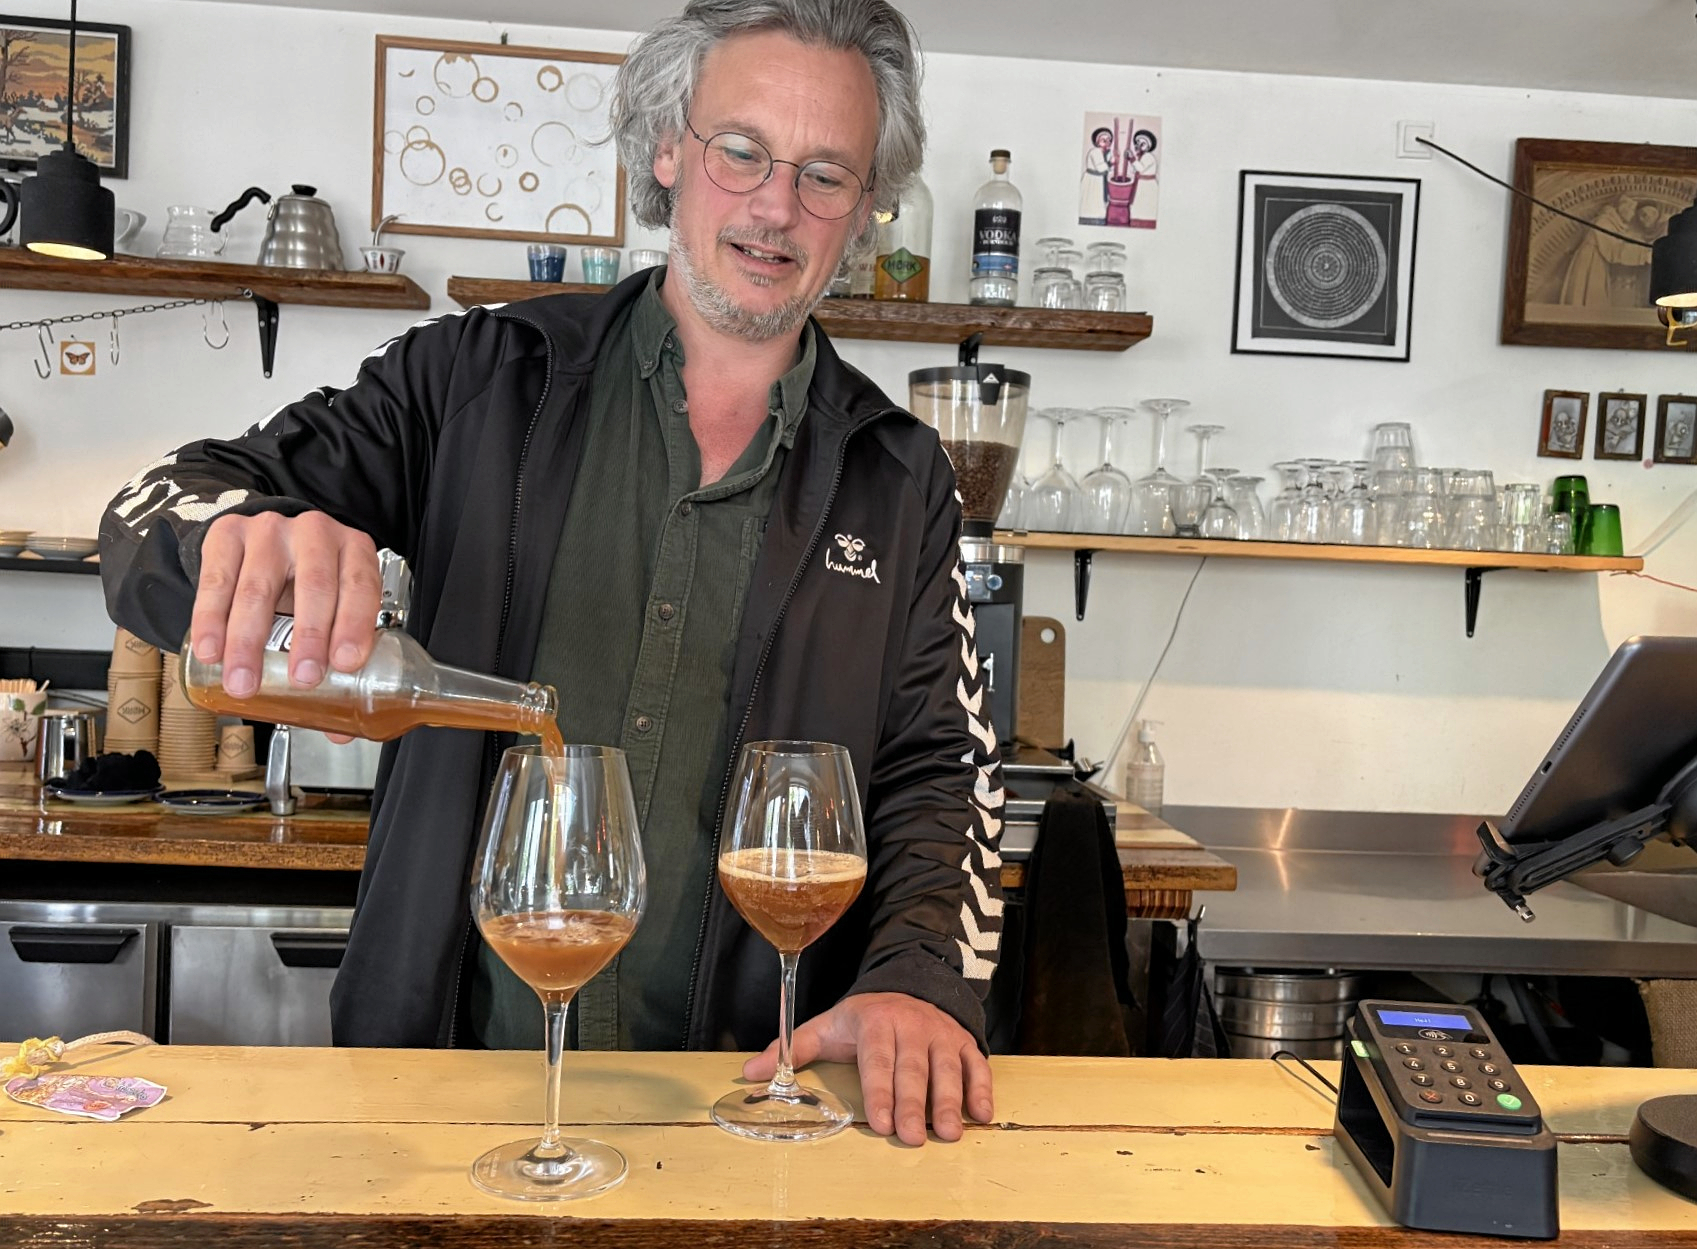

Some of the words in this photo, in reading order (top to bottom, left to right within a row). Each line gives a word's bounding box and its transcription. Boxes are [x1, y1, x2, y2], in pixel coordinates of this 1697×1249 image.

[979, 229, 1017, 240] VODKA
[825, 547, 881, 584] hummel
[1438, 1047, 1448, 1055] 2
[1447, 1062, 1456, 1070] 5
[1484, 1065, 1494, 1073] 6
[1417, 1075, 1426, 1083] 7
[1456, 1078, 1466, 1086] 8
[1494, 1081, 1504, 1089] 9
[1464, 1094, 1475, 1102] 0
